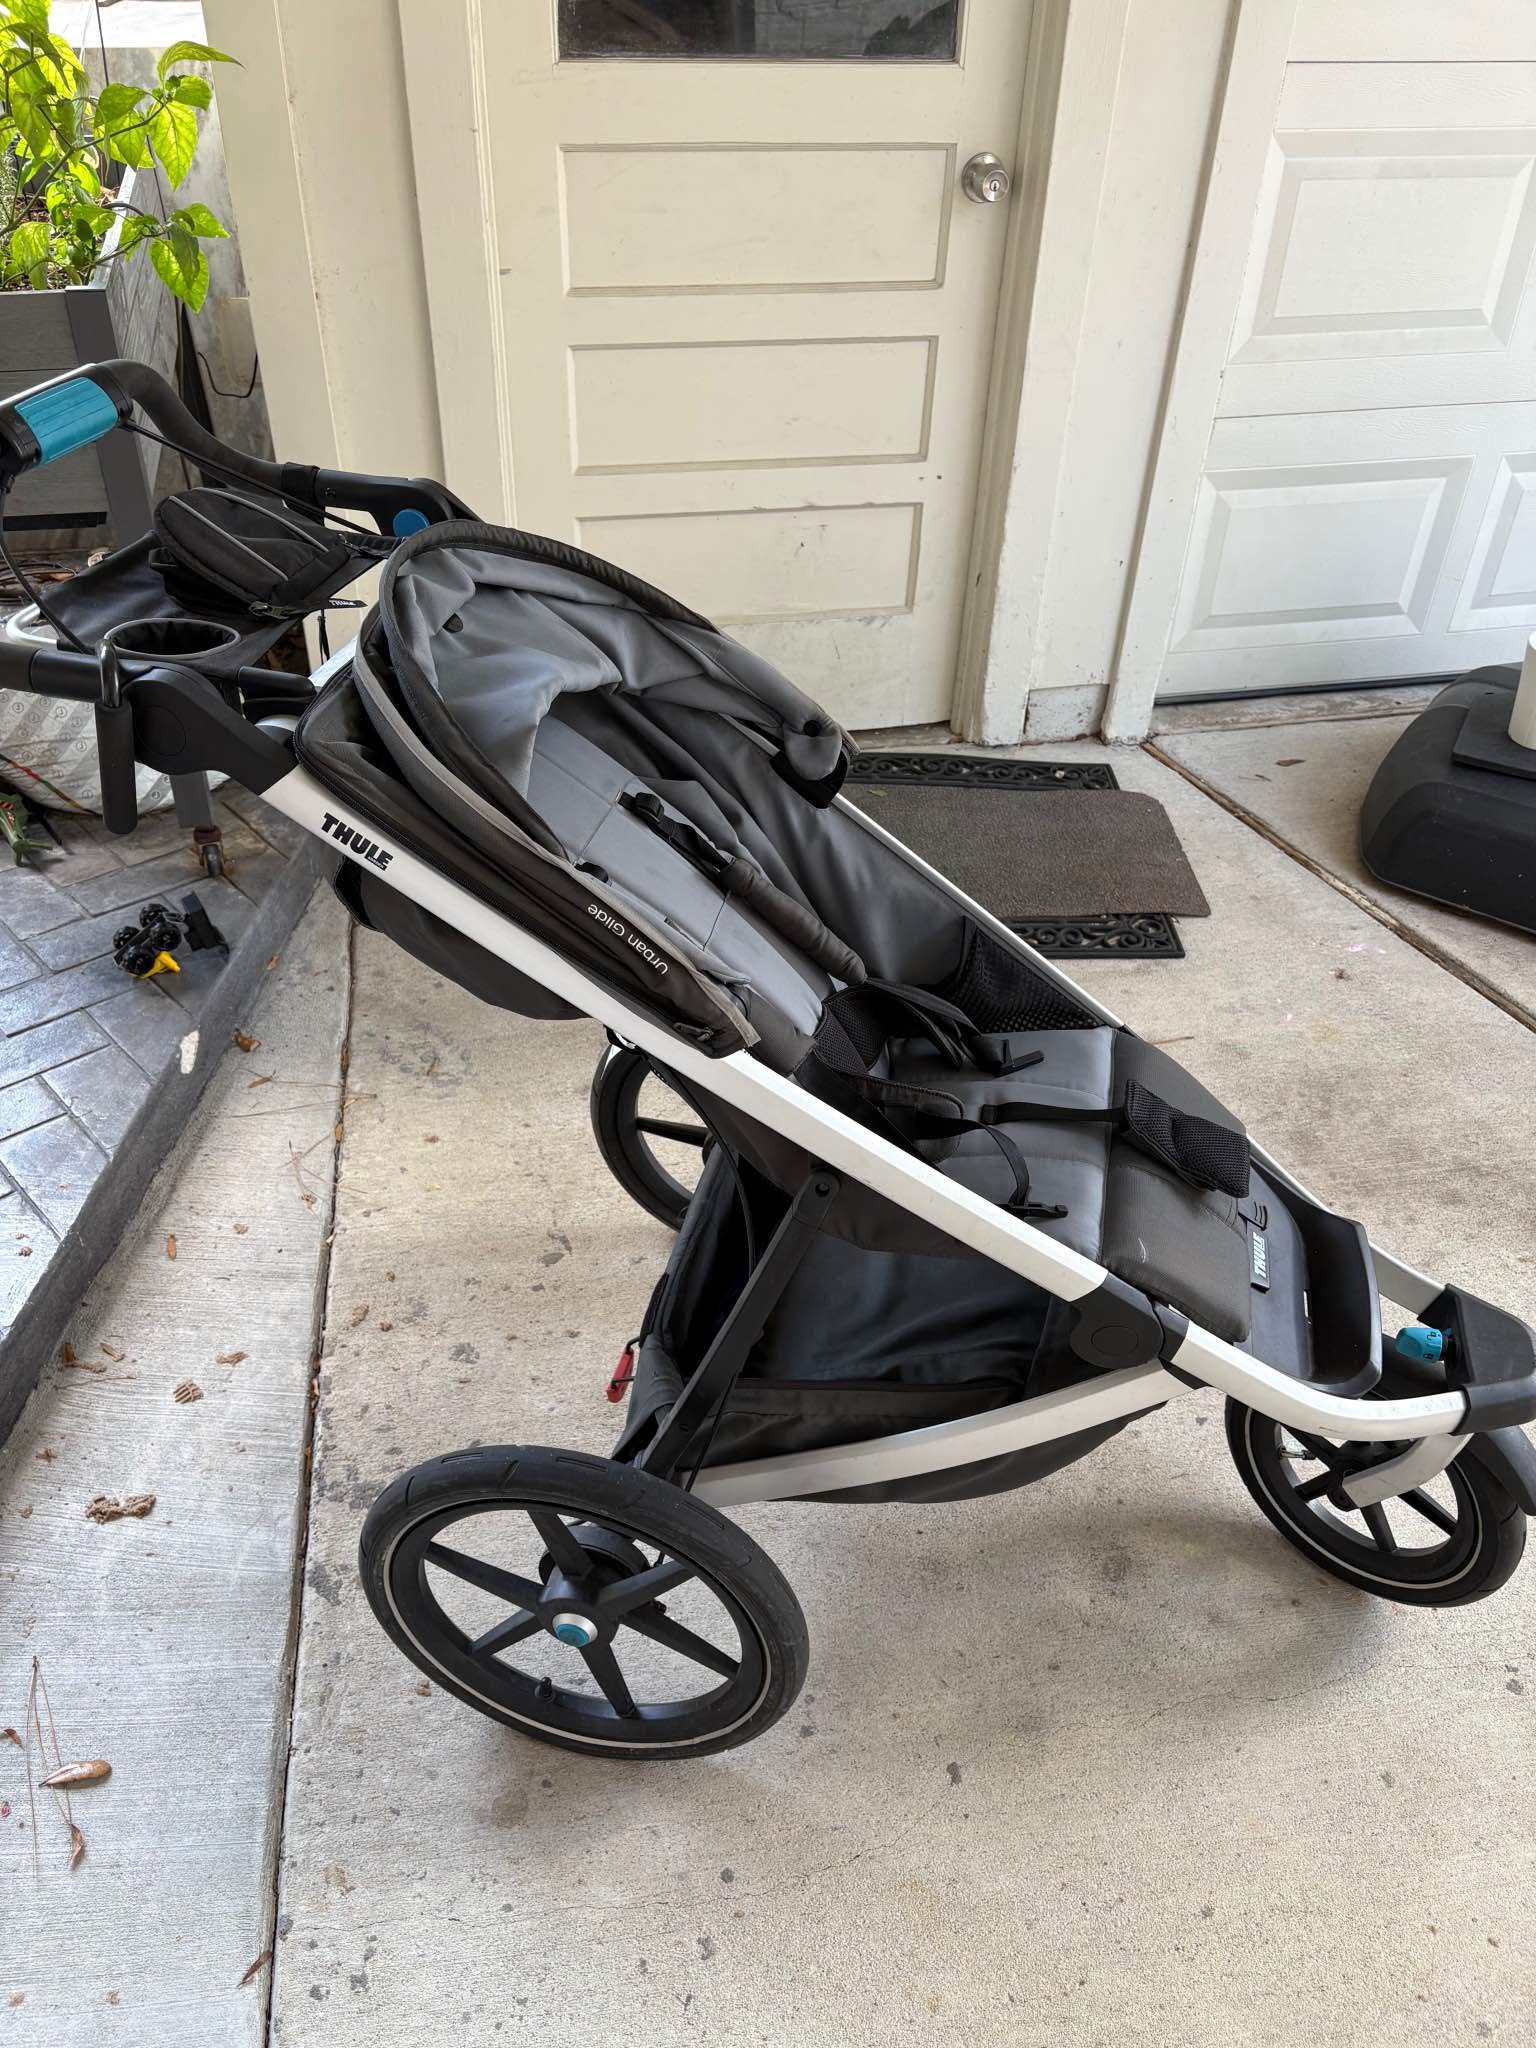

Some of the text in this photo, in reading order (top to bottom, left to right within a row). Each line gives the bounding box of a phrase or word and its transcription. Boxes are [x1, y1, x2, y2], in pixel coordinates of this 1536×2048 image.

[321, 812, 393, 871] THULE
[588, 904, 668, 974] Urban Glide
[1253, 1232, 1266, 1278] THULE
